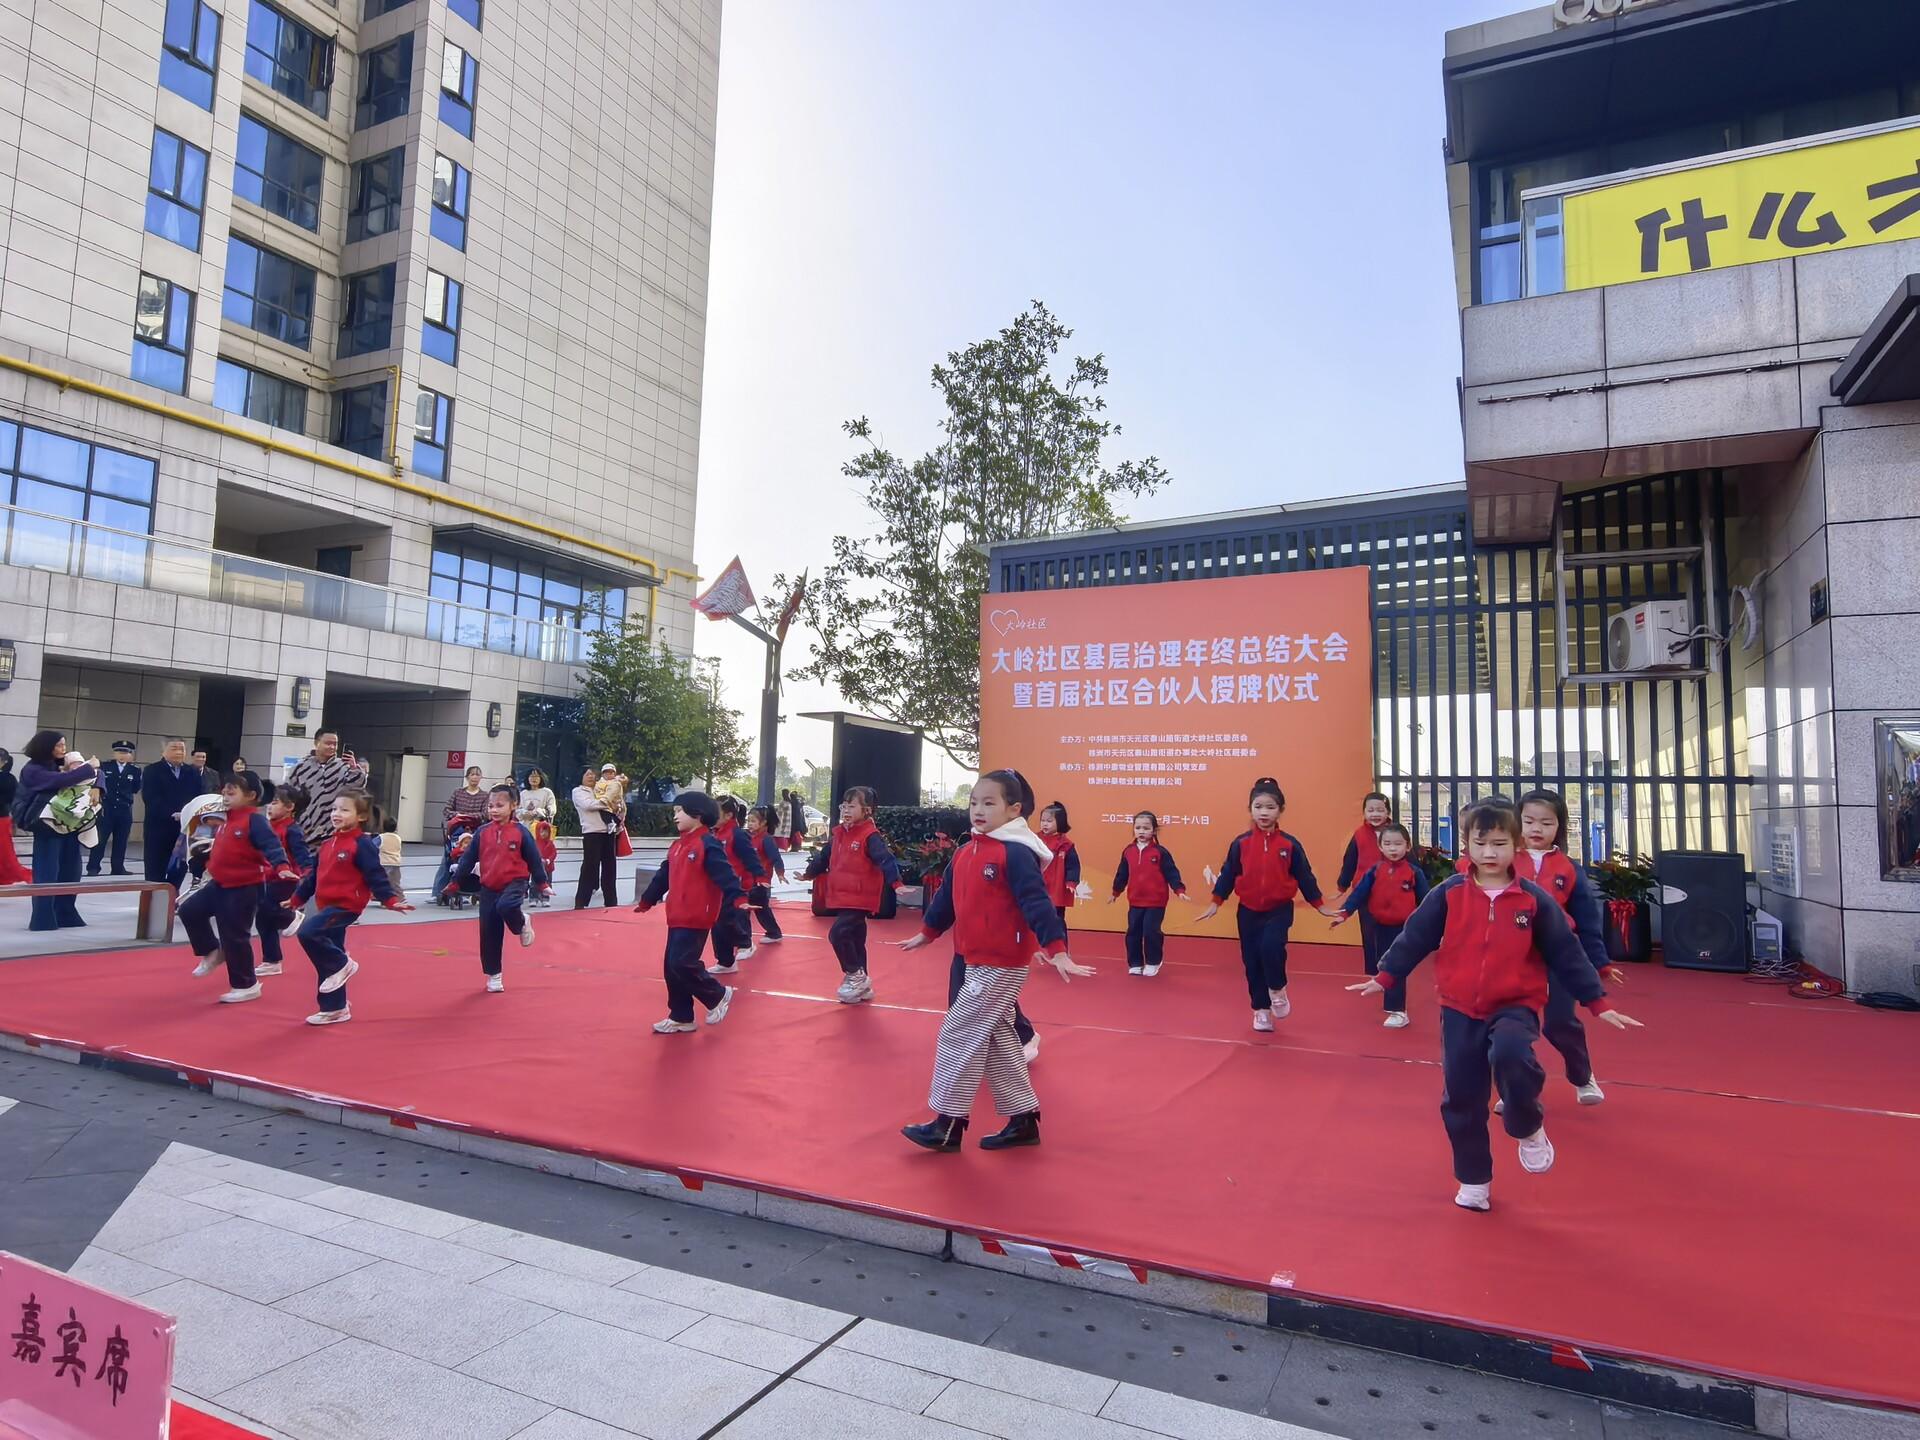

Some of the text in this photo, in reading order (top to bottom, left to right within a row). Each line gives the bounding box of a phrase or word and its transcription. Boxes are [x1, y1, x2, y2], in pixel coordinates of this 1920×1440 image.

[991, 631, 1349, 674] 大岭社区基层治理年终总结大会
[1012, 672, 1320, 709] 暨首届社区合伙人授牌仪式
[11, 1292, 130, 1407] 嘉宾席
